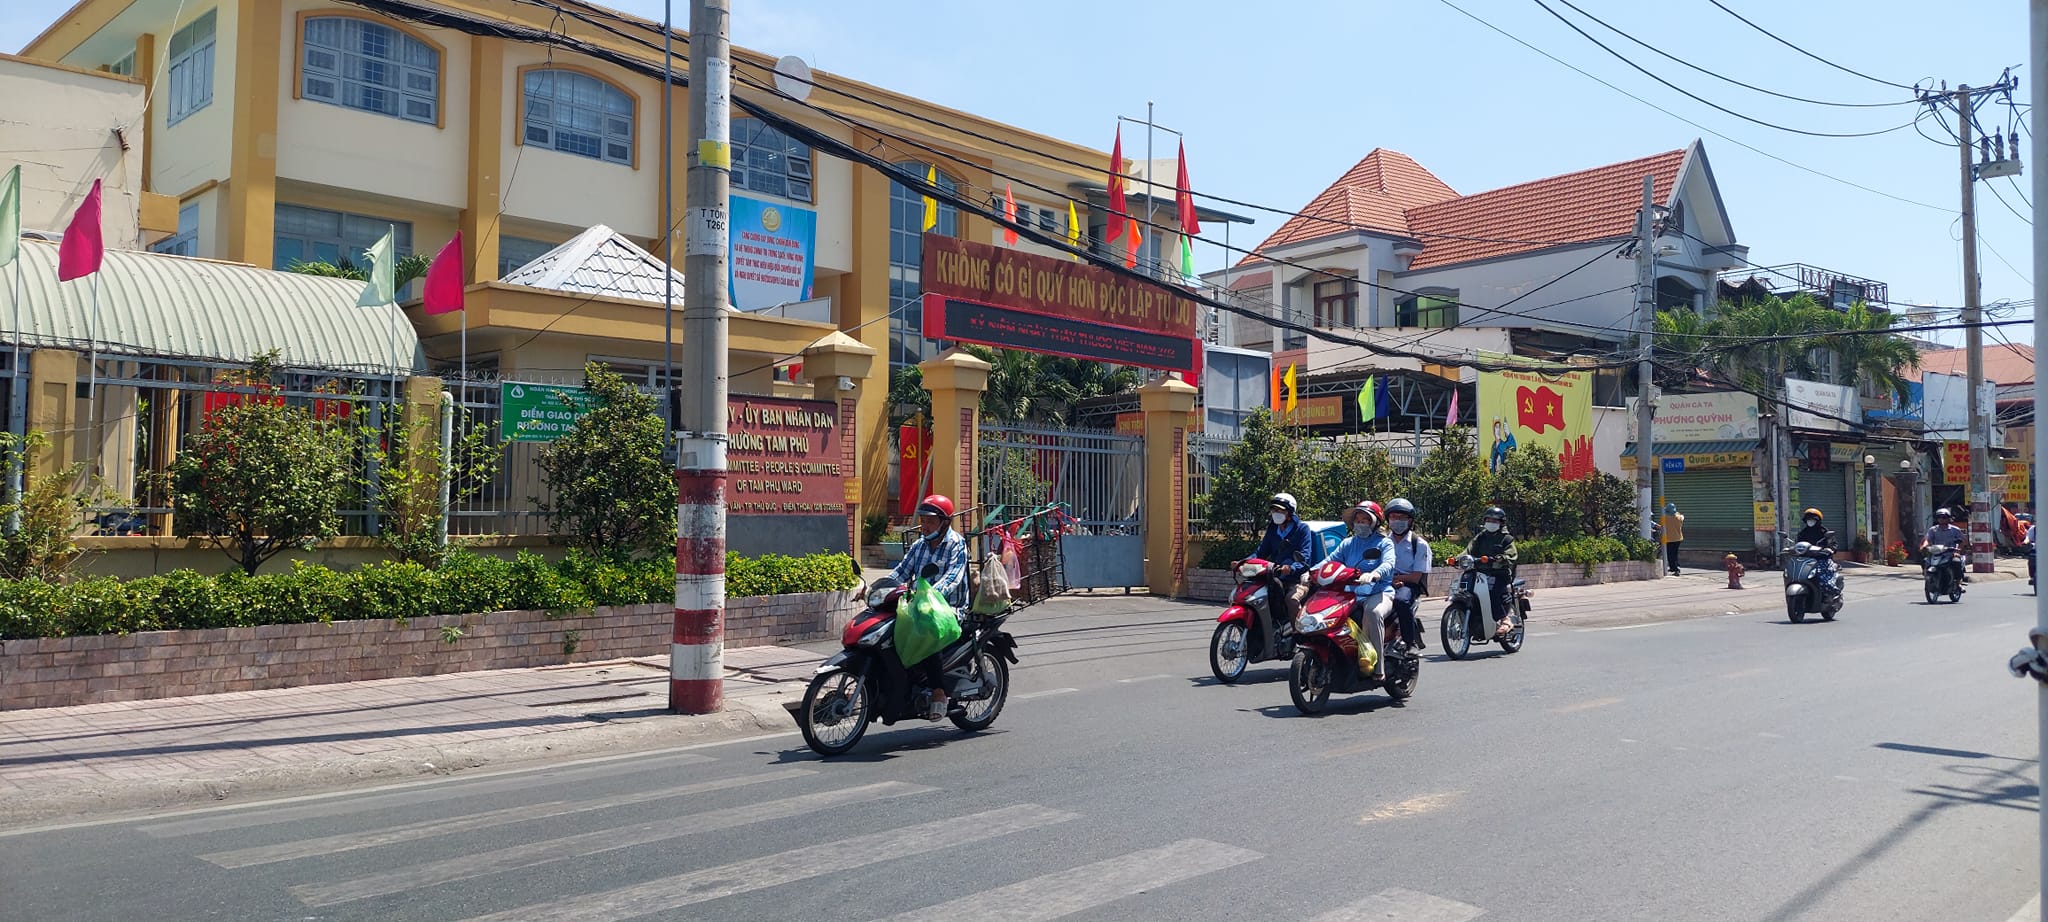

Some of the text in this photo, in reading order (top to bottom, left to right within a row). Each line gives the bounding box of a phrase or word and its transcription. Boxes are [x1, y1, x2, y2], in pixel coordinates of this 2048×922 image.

[936, 247, 1190, 329] KHÔNG CÓ GÌ QUÝ HƠN ĐỘC LẬP TỰ DO
[521, 405, 545, 419] ĐIỂM
[547, 411, 571, 421] GIAO
[745, 400, 759, 424] ỦY
[762, 408, 783, 426] BAN
[785, 406, 812, 428] NHÂN
[1653, 414, 1695, 425] PHƯƠNG
[727, 429, 810, 453] HƯỜNG TAM PHÚ
[765, 462, 800, 474] PEOPLE'S
[801, 463, 841, 475] COMMITTEE
[736, 479, 803, 492] OF TAM PHU WARD
